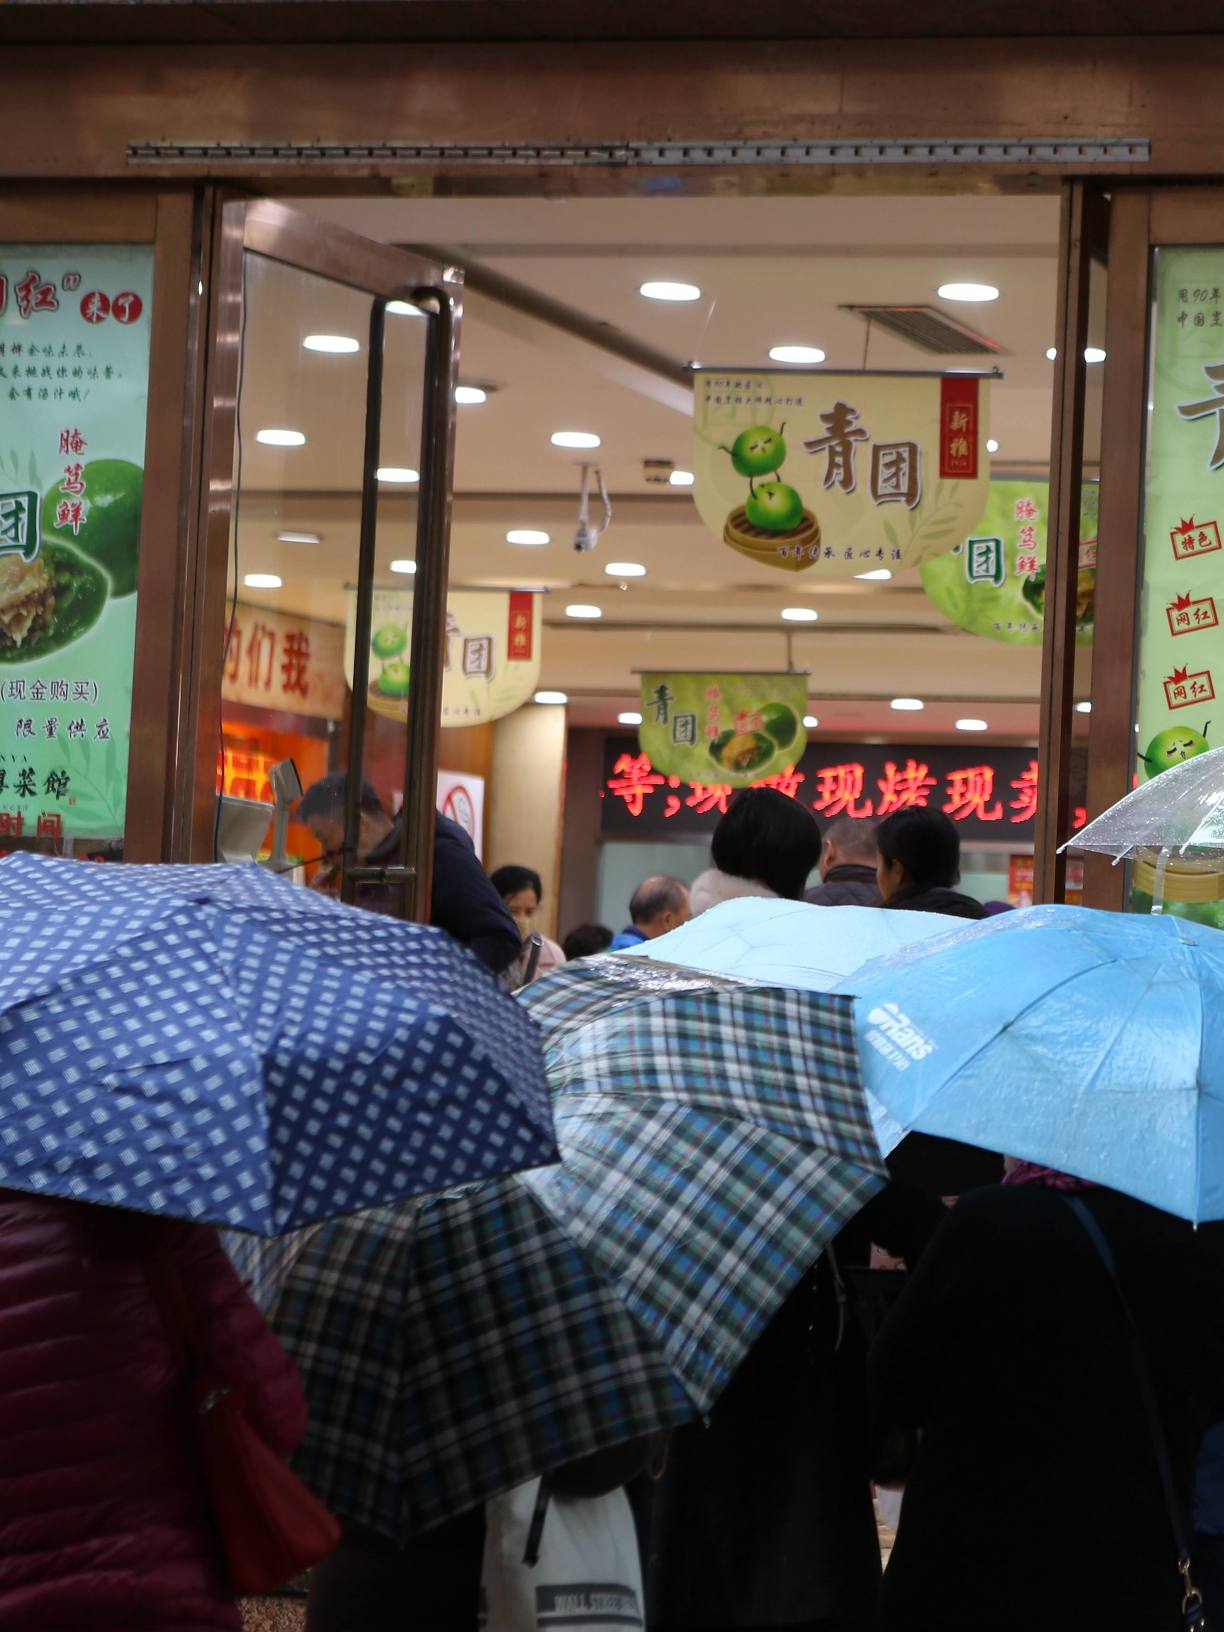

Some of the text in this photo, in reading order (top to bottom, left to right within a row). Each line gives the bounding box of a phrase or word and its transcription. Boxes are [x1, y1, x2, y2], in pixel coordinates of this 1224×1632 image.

[949, 409, 969, 459] 新雅
[802, 399, 922, 511] 青团
[54, 428, 89, 535] 腌笃鲜
[1180, 529, 1213, 552] 特色
[1175, 606, 1213, 627] 网红
[1172, 679, 1208, 701] 网红
[15, 717, 112, 740] 限量供应
[645, 683, 698, 747] 青团
